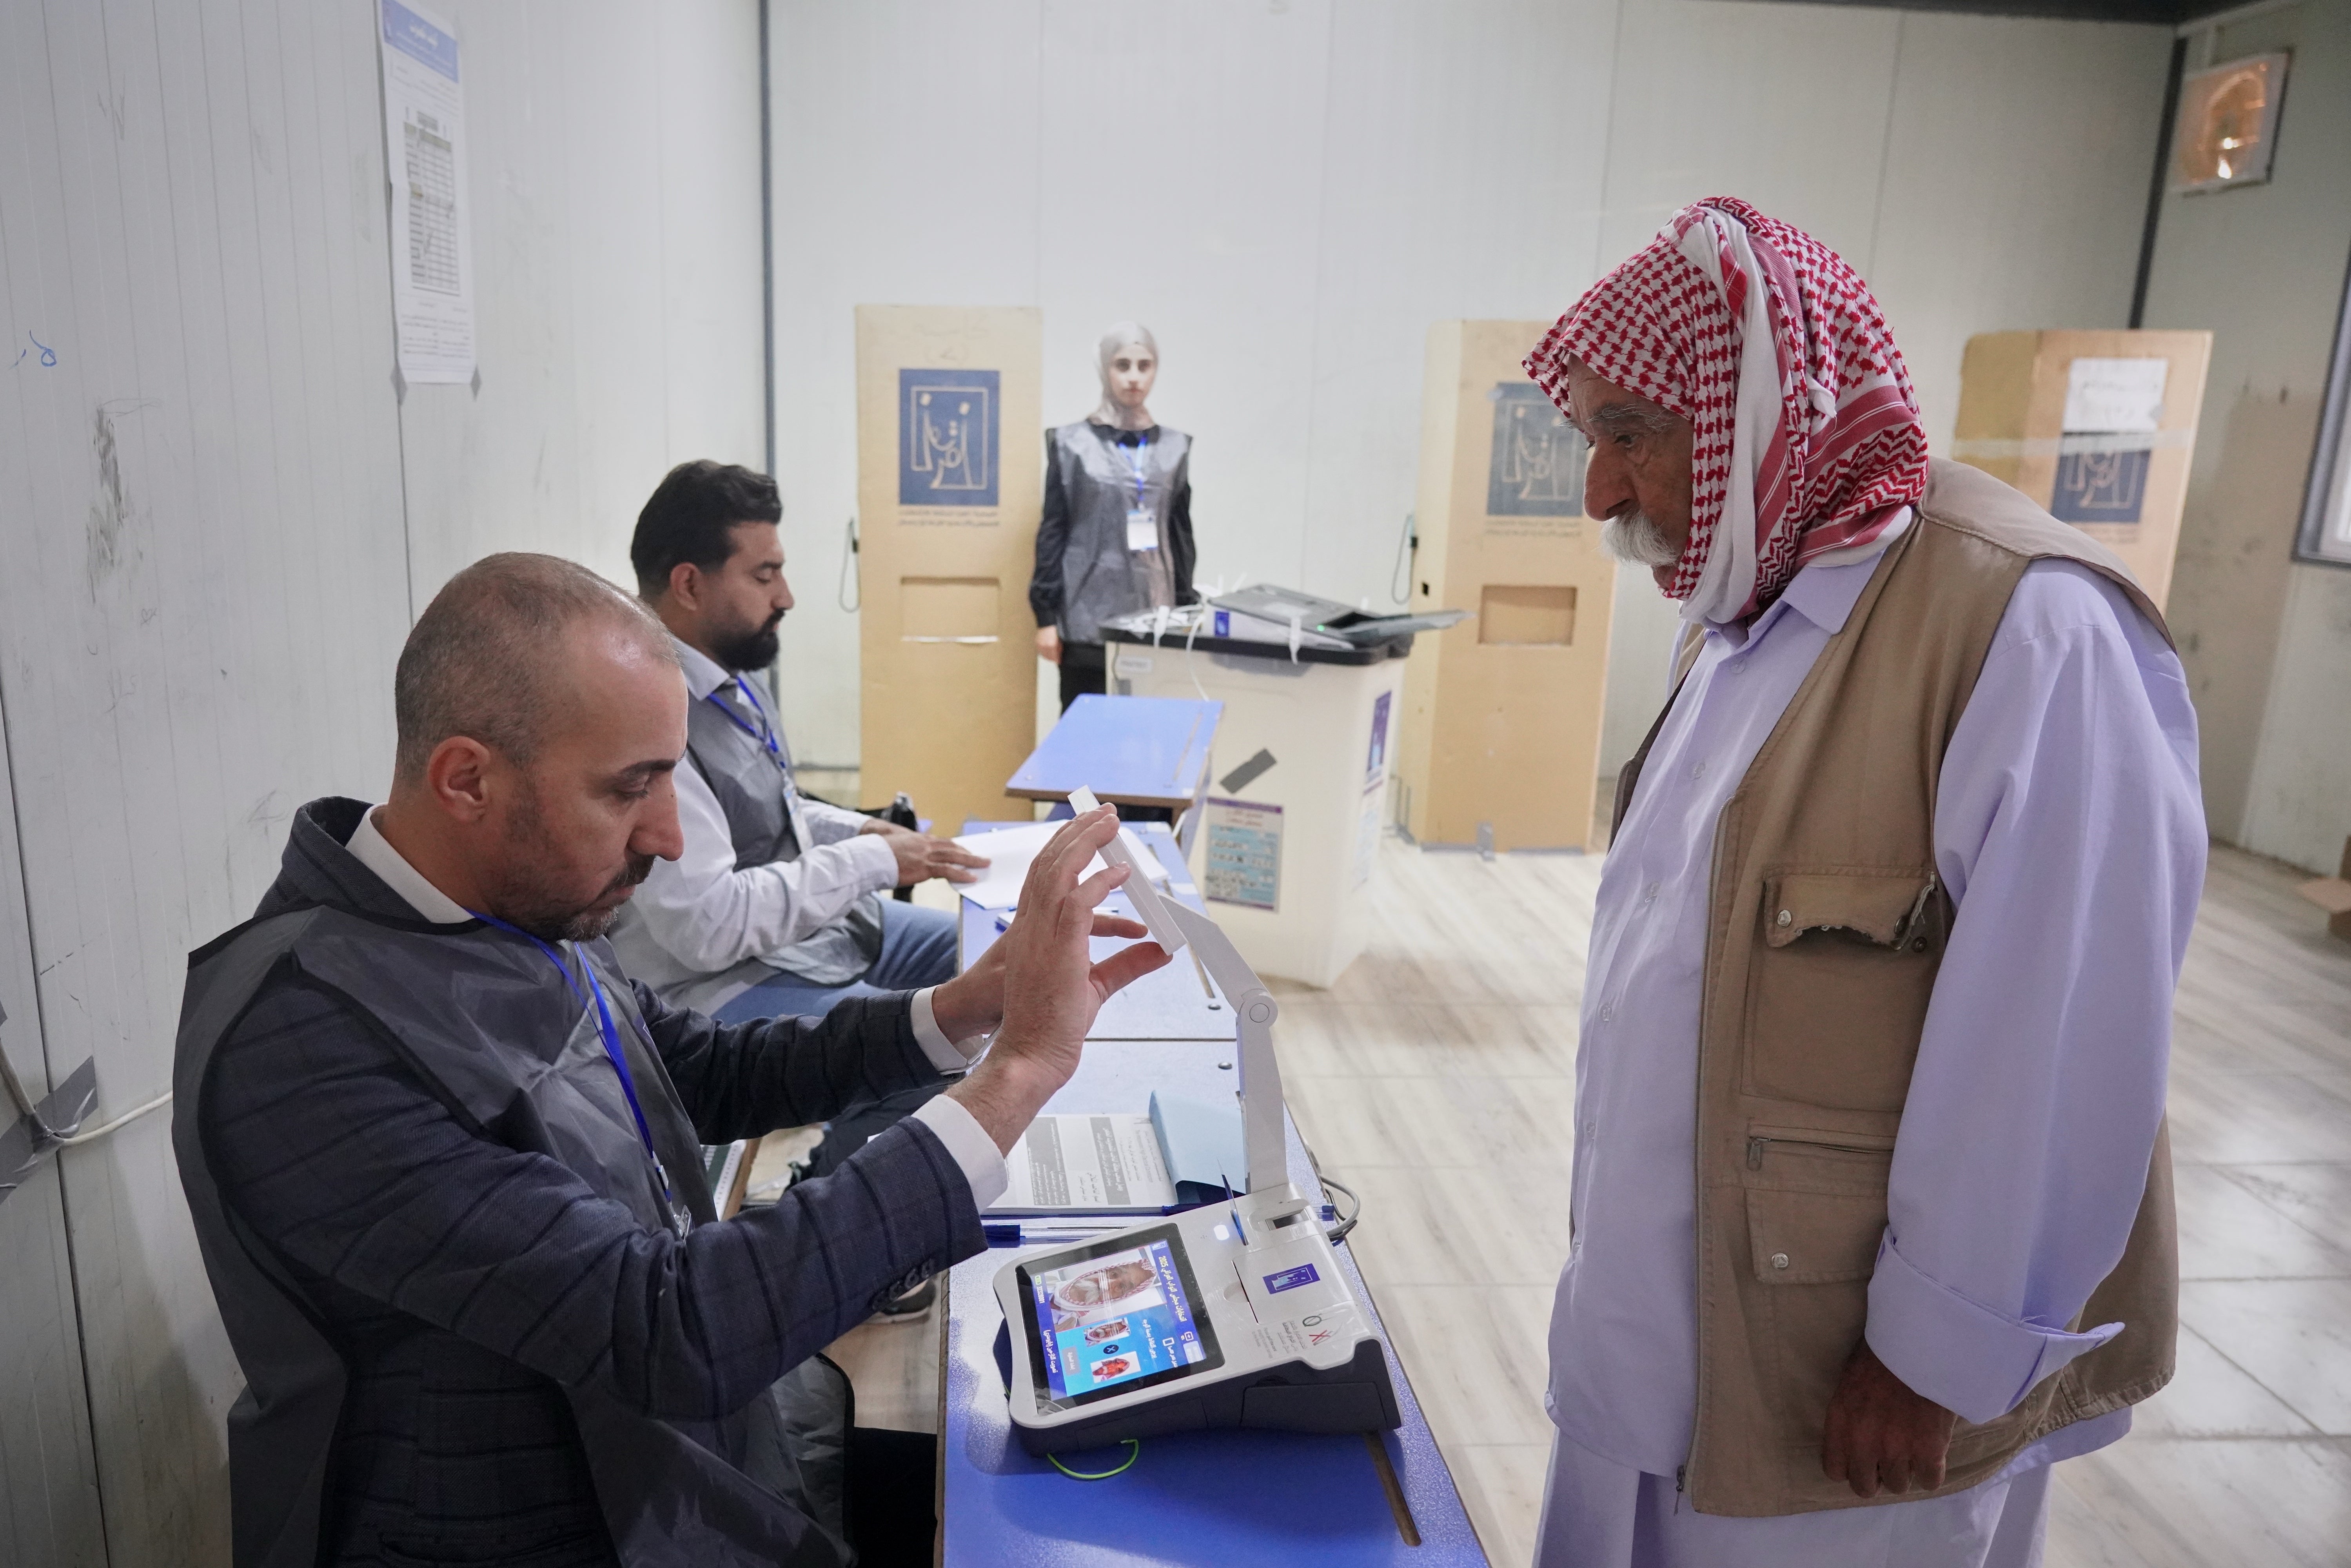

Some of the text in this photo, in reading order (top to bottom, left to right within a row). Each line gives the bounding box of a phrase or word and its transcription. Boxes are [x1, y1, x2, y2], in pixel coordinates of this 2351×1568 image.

[1036, 1286, 1045, 1303] 32328001
[1158, 1256, 1187, 1323] انتخابات مجلس النواب العراقي 2025
[1142, 1318, 1150, 1328] الوجه
[1144, 1328, 1153, 1338] بصمة
[1148, 1337, 1156, 1348] التقاط
[1049, 1360, 1058, 1373] تصويت
